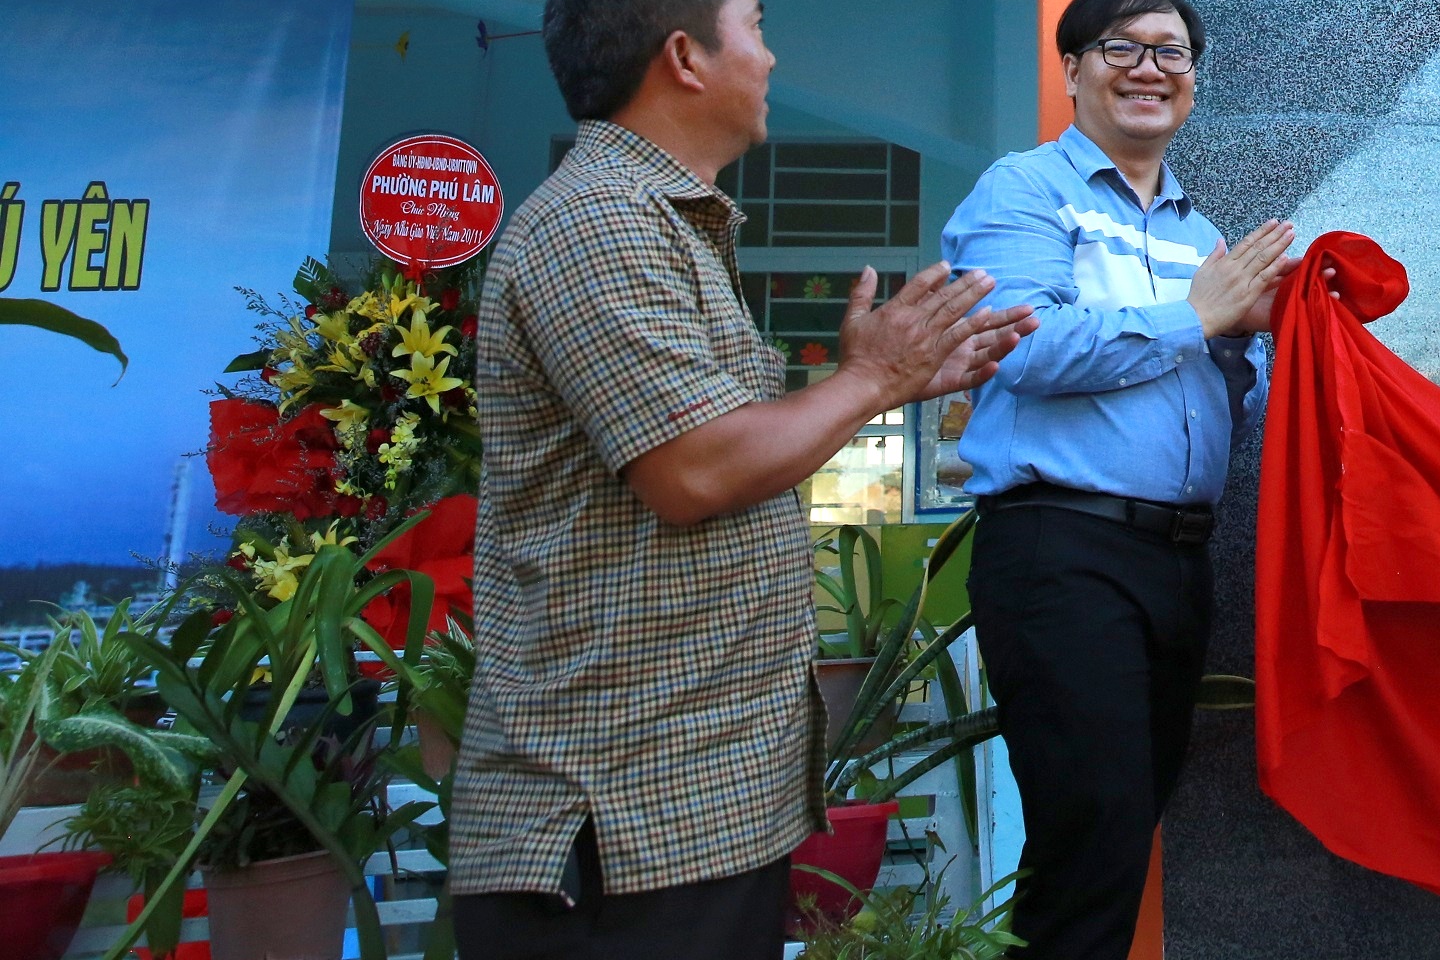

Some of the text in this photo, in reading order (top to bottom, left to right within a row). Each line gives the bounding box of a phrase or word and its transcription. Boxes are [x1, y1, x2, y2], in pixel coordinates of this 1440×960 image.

[372, 173, 495, 203] PHƯỜNG PHÚ LÂM
[40, 181, 150, 292] YÊN
[460, 228, 483, 245] 20/11
